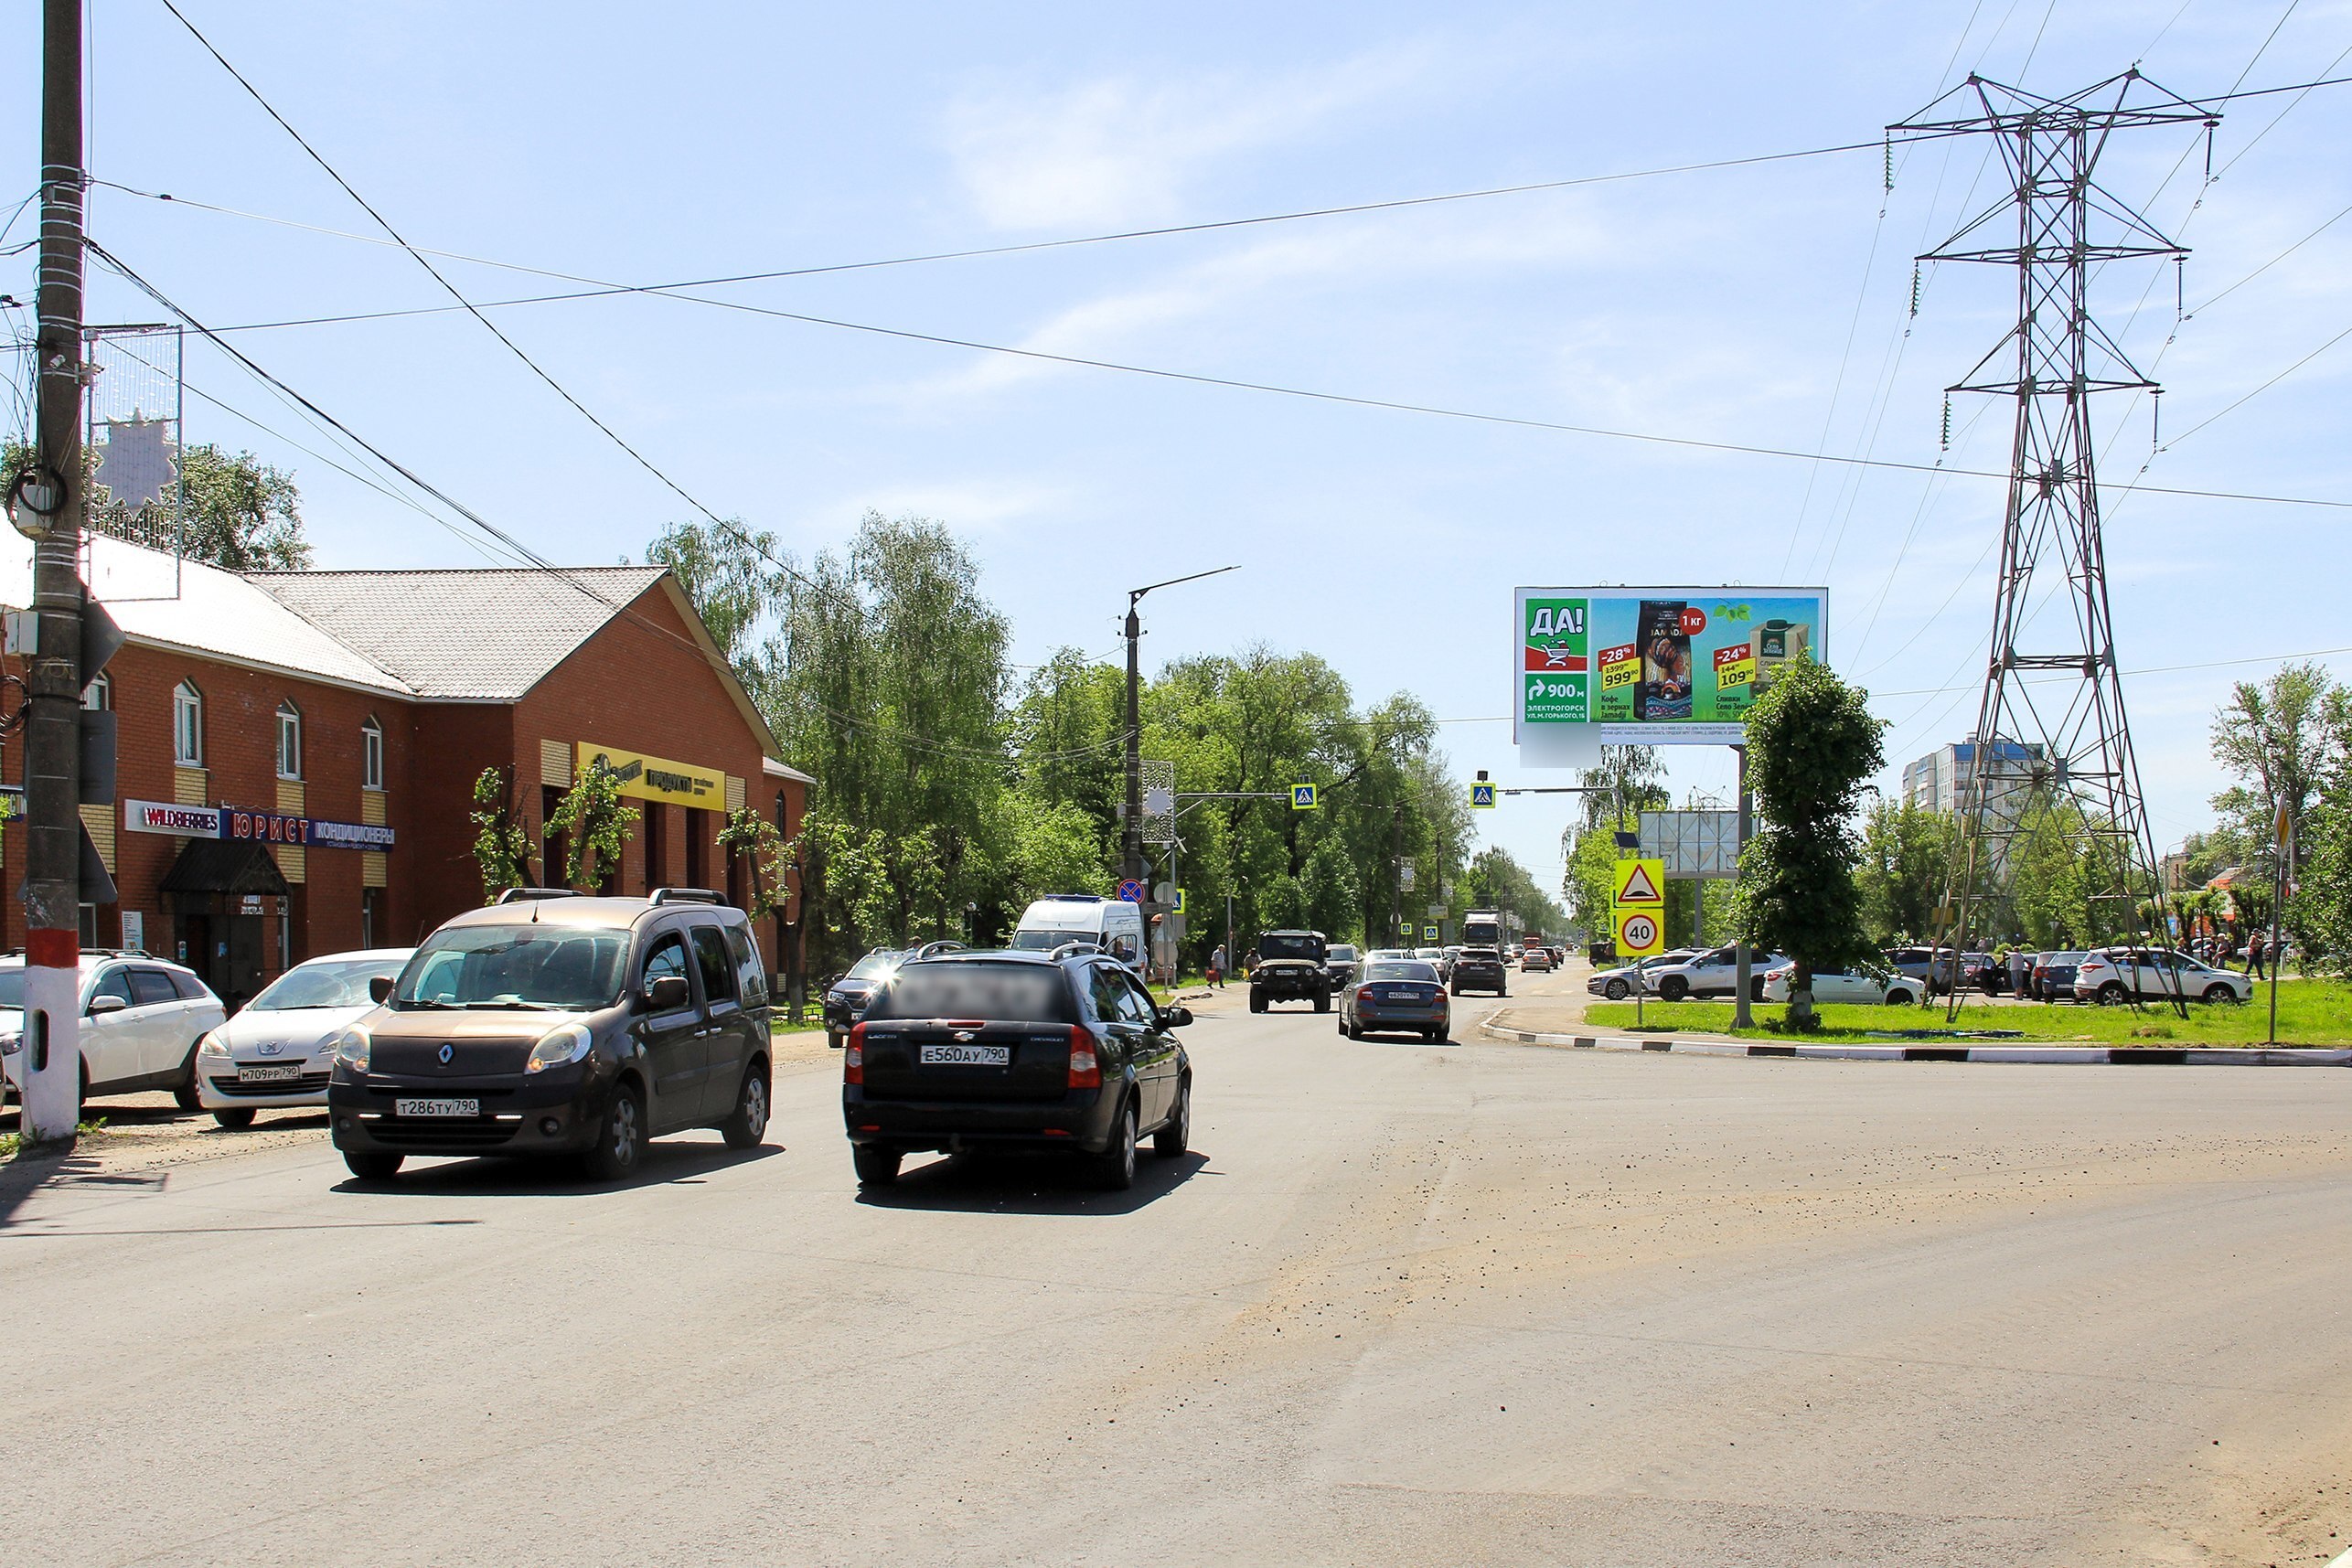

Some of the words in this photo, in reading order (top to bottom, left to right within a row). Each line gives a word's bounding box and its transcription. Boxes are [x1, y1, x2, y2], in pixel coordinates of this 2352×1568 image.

[1530, 607, 1585, 637] ДА!
[1683, 616, 1688, 626] 1
[1691, 617, 1702, 627] кг
[1601, 647, 1631, 664] -28%
[1717, 646, 1747, 663] -24%
[1547, 684, 1576, 698] 900
[1601, 695, 1619, 704] Кофе
[1716, 695, 1741, 703] Сливки
[1716, 702, 1732, 710] Село
[1601, 709, 1627, 720] Jamadji
[144, 806, 219, 832] WILDBERRIES
[233, 813, 309, 843] ЮРИСТ
[315, 821, 395, 845] КОНДИЦИОНЕРЫ
[1630, 925, 1650, 940] 40
